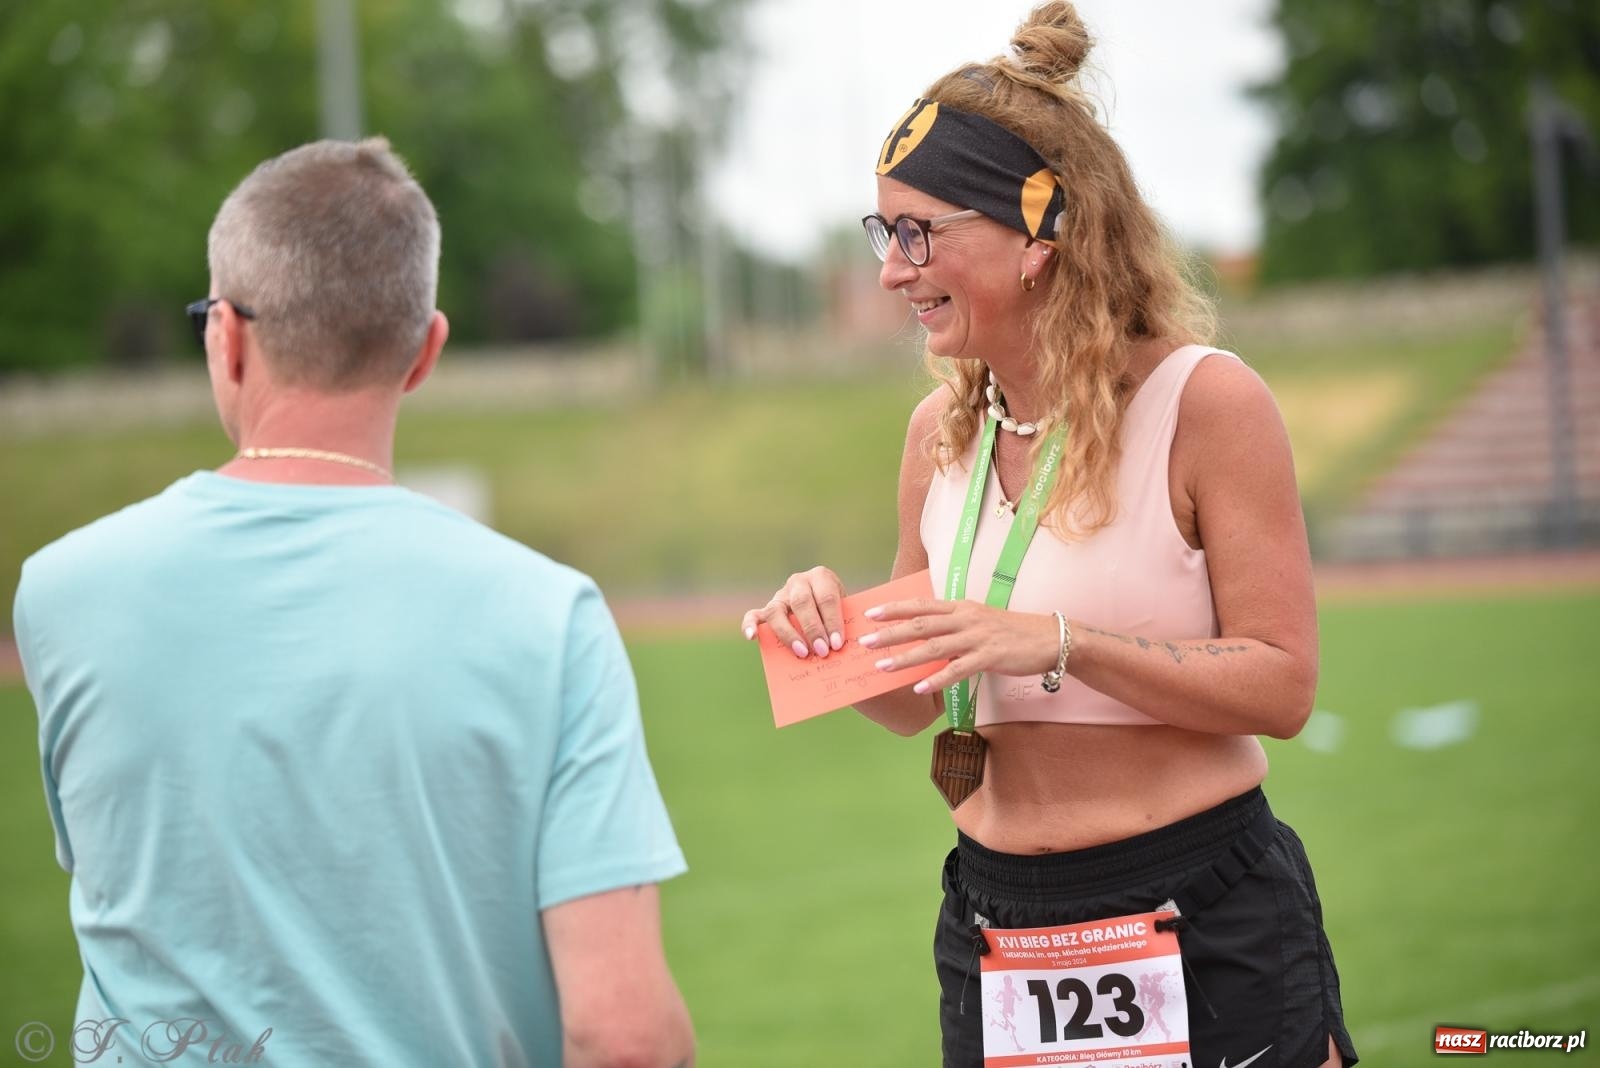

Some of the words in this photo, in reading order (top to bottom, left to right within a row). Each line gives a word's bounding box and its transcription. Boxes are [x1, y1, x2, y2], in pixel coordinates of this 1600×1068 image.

[996, 935, 1018, 950] XVI
[1021, 932, 1050, 949] BIEG
[1052, 928, 1079, 947] BEZ
[1081, 921, 1147, 943] GRANIC
[1047, 950, 1061, 960] asp.
[1062, 946, 1091, 957] Michała
[1092, 938, 1147, 955] Kędzierskiego
[1071, 957, 1087, 966] 2024
[1026, 973, 1145, 1043] 123
[1036, 1053, 1079, 1064] KATEGORIA:
[1079, 1052, 1095, 1062] Bieg
[1096, 1050, 1121, 1060] Główny
[1131, 1048, 1142, 1056] km
